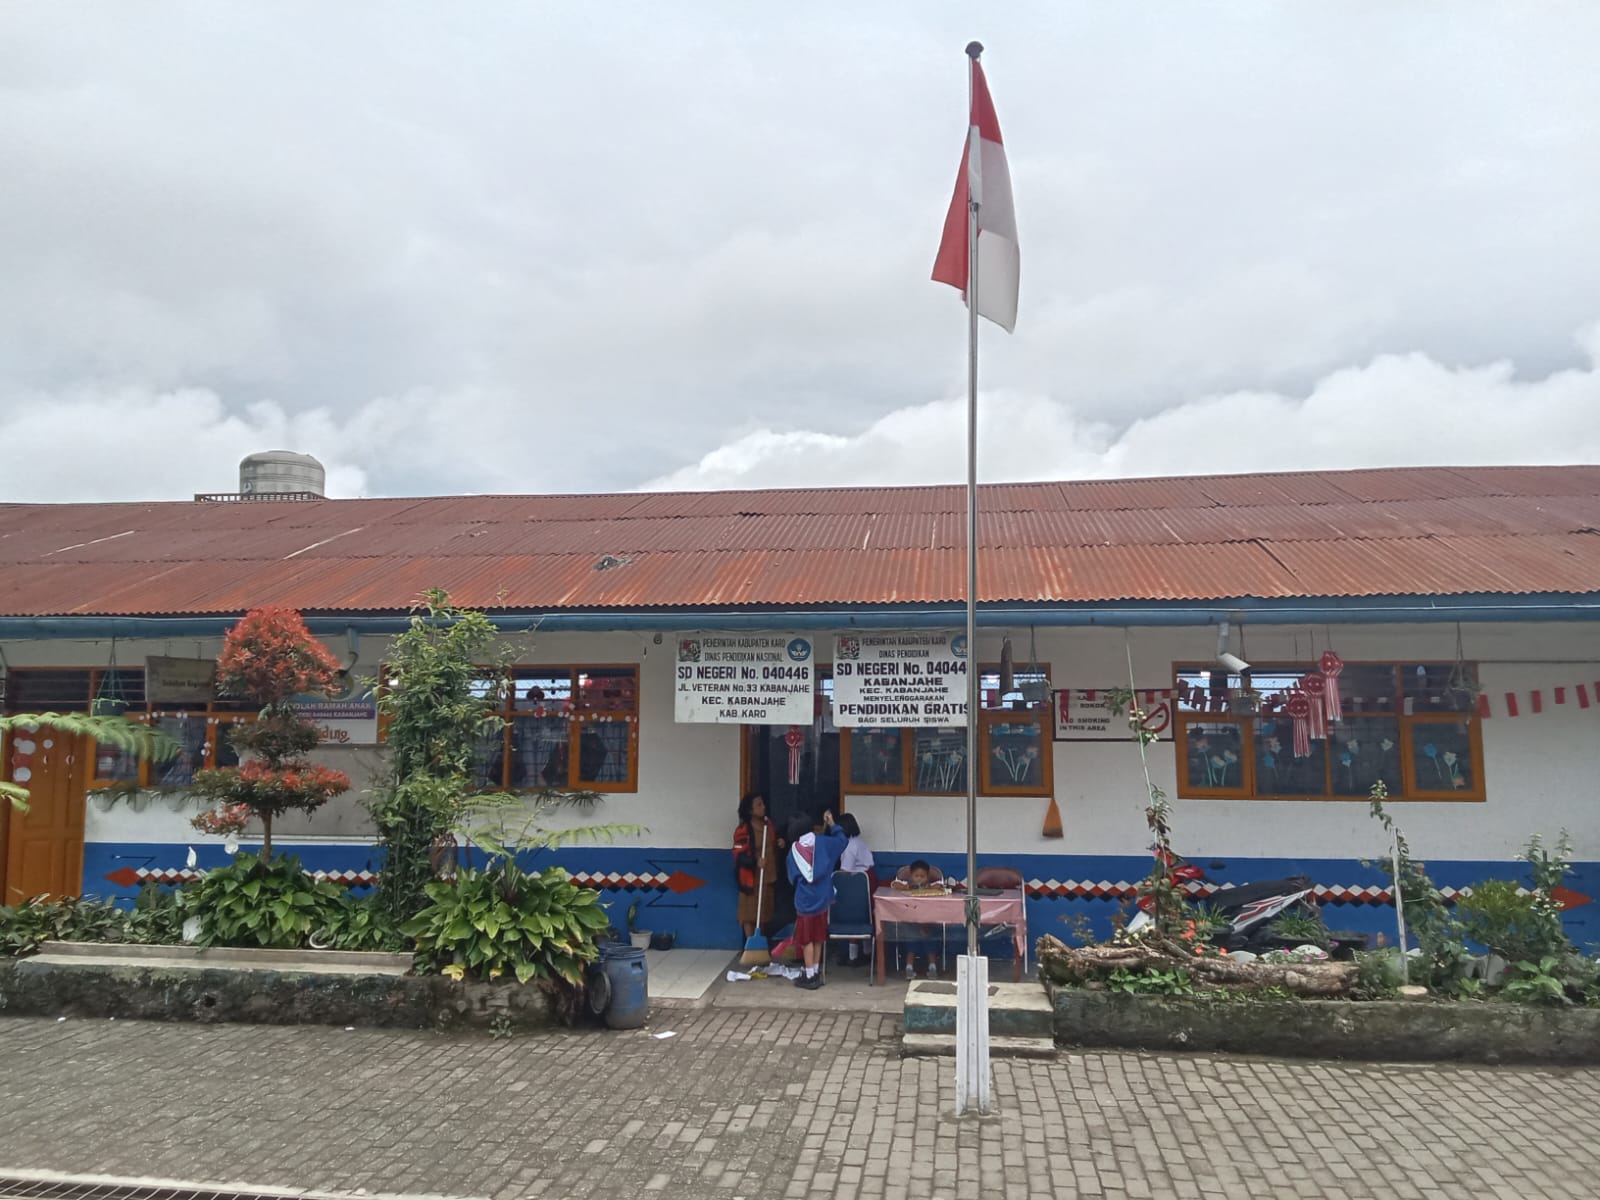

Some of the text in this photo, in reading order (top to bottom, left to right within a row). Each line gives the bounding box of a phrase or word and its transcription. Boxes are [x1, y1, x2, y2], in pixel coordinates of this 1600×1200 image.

[703, 638, 786, 649] PEMERINTAH KABUPATEN KARO
[931, 637, 946, 645] KARO
[704, 652, 783, 662] DINAS PENDIDIKAN NASIONAL
[879, 650, 929, 658] DINAS PENDIDIKAN
[678, 666, 809, 680] SD NEGERI No. 040446
[837, 661, 967, 676] SD NEGERI No. 04044
[864, 677, 943, 687] KABANJAHE
[692, 684, 730, 692] VETERAN
[760, 684, 810, 693] KABANJAHE
[702, 696, 786, 706] KEC. KABANJAHE
[742, 709, 766, 718] KARO
[840, 703, 919, 715] PENDIDIKAN
